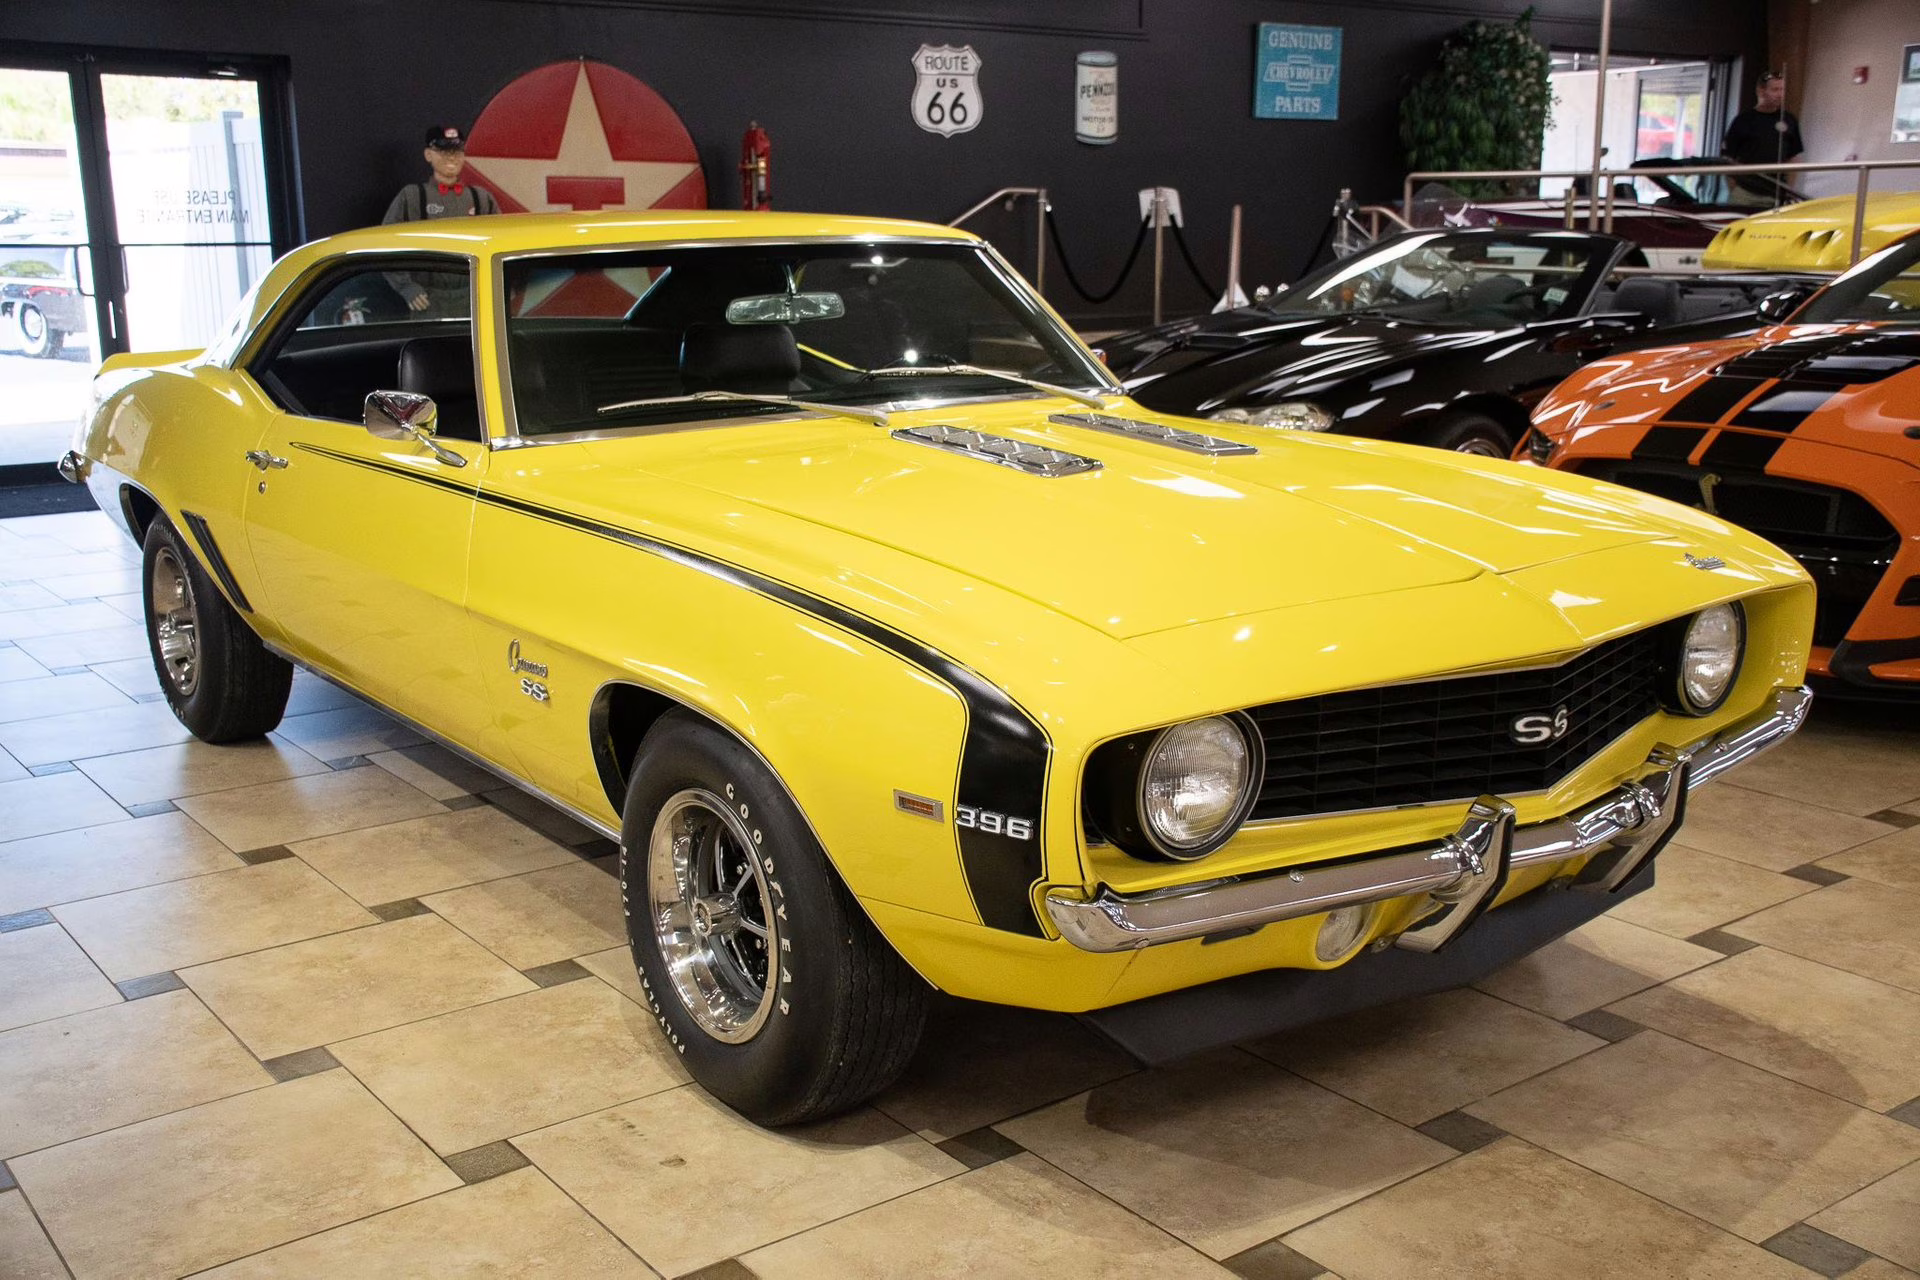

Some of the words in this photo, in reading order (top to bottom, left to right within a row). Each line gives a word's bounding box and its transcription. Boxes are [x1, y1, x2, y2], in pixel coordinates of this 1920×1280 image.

[1268, 31, 1333, 50] GENUINE
[924, 56, 969, 71] ROUTE
[1266, 65, 1329, 82] CHEVROLET
[927, 91, 967, 125] 66
[1274, 95, 1321, 113] PARTS
[520, 678, 550, 701] SS
[1513, 704, 1568, 743] SS
[955, 803, 1034, 841] 396
